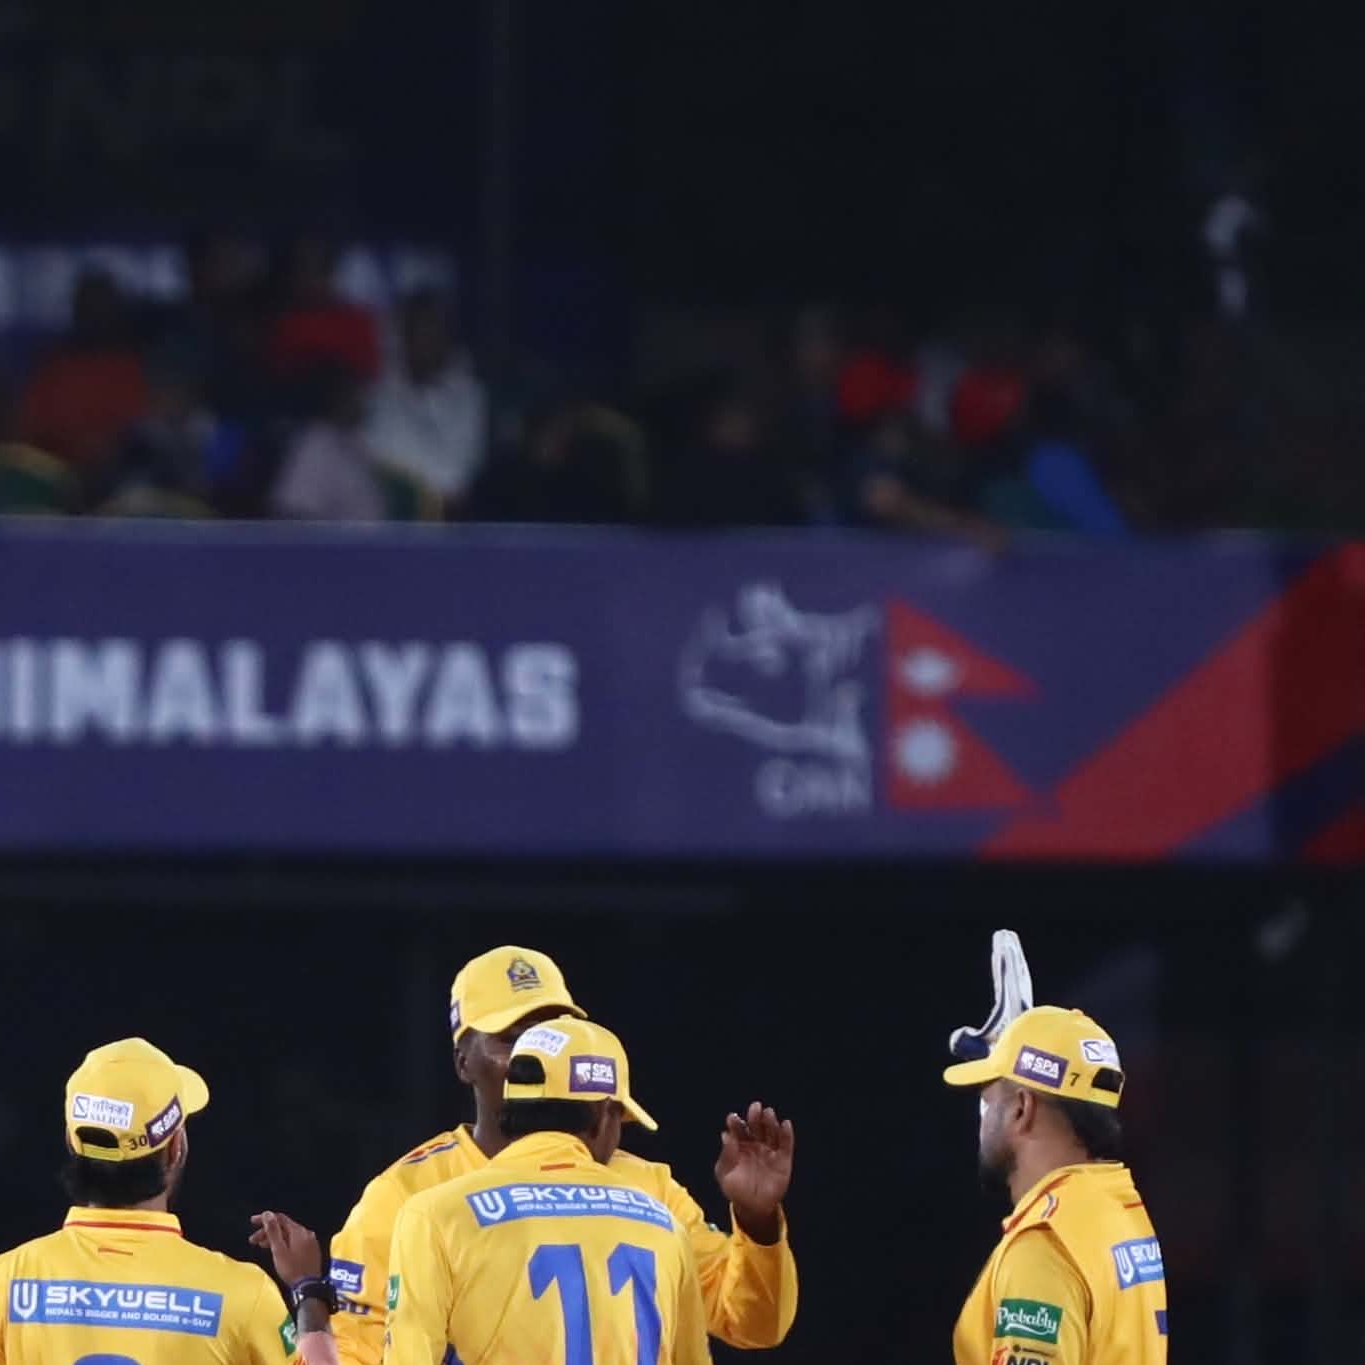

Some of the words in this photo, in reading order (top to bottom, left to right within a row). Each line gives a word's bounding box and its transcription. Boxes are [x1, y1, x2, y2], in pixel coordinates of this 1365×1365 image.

[1069, 1071, 1081, 1087] 7
[44, 1285, 216, 1317] SKYWELL
[997, 1305, 1058, 1335] Probably
